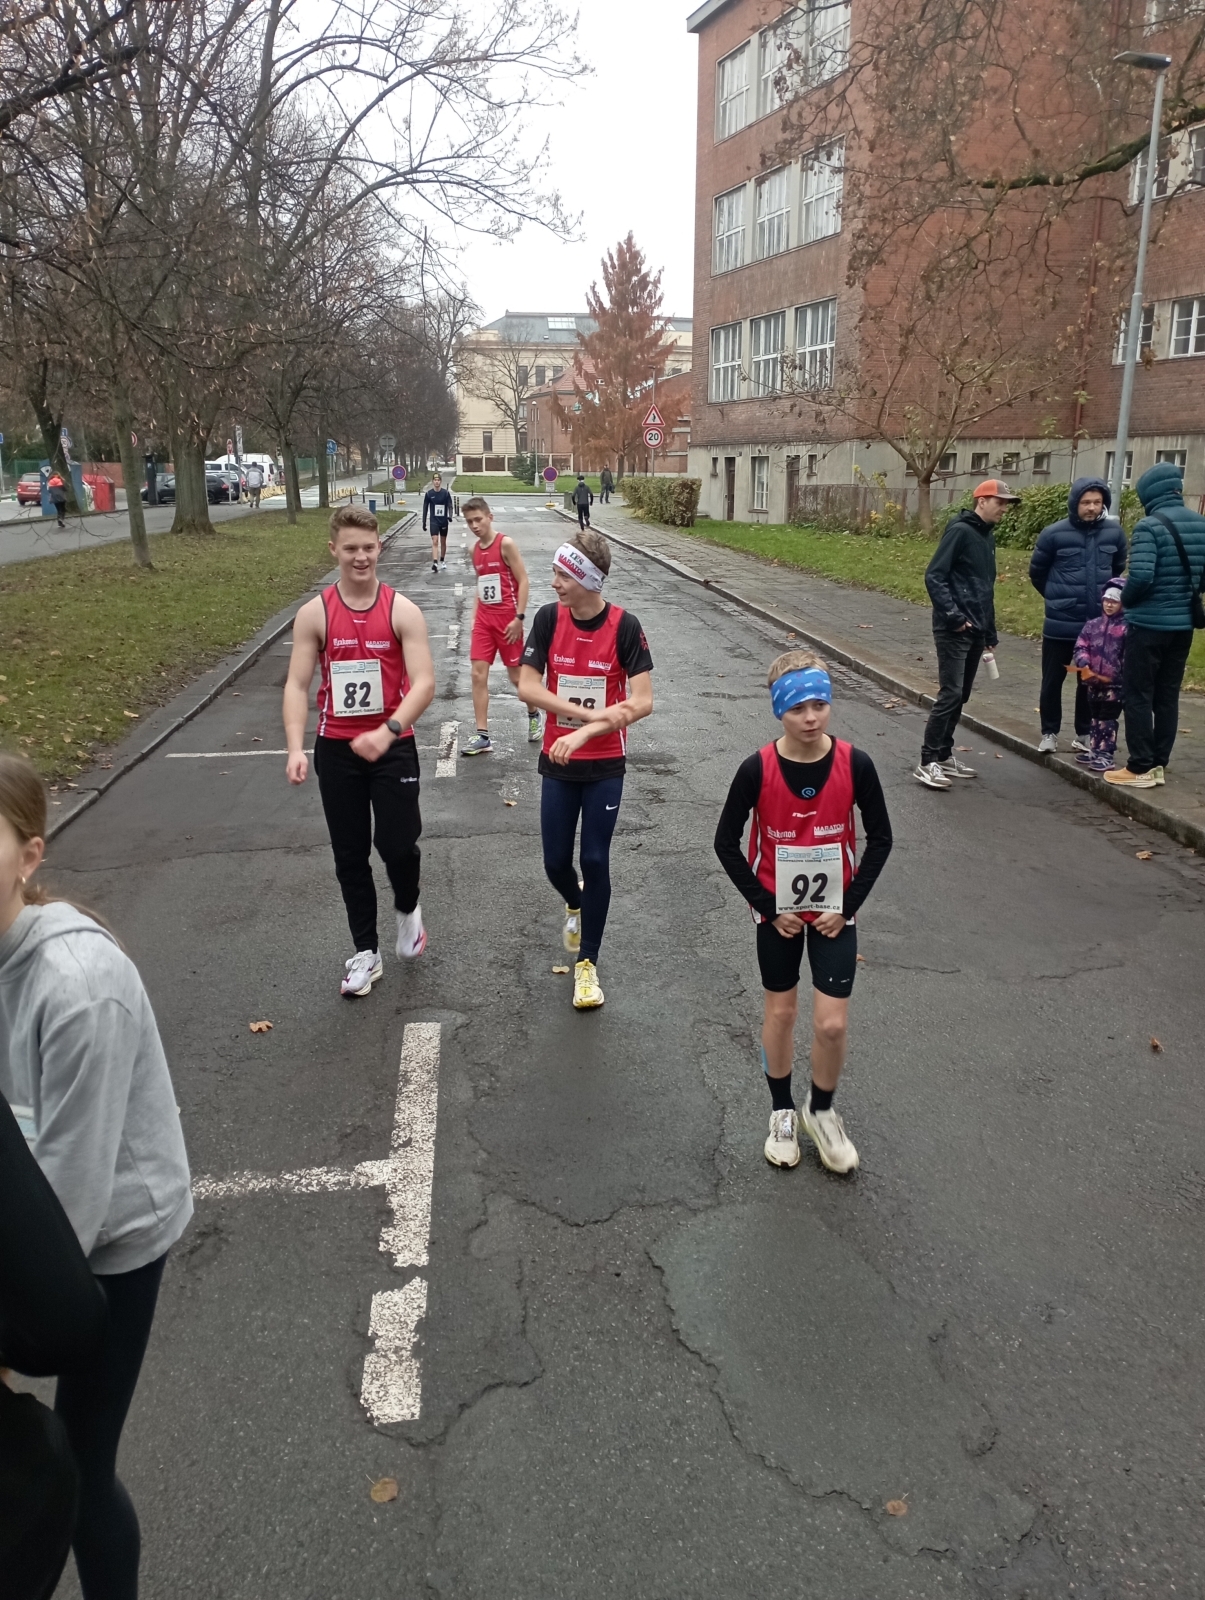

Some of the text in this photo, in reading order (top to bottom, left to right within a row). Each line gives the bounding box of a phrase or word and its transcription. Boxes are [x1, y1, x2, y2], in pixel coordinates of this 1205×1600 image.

[648, 433, 659, 441] 20
[558, 553, 587, 580] MARATON
[570, 552, 585, 566] LES
[483, 585, 496, 600] 83
[343, 681, 371, 709] 82
[813, 823, 845, 833] MARATON
[791, 872, 828, 905] 92
